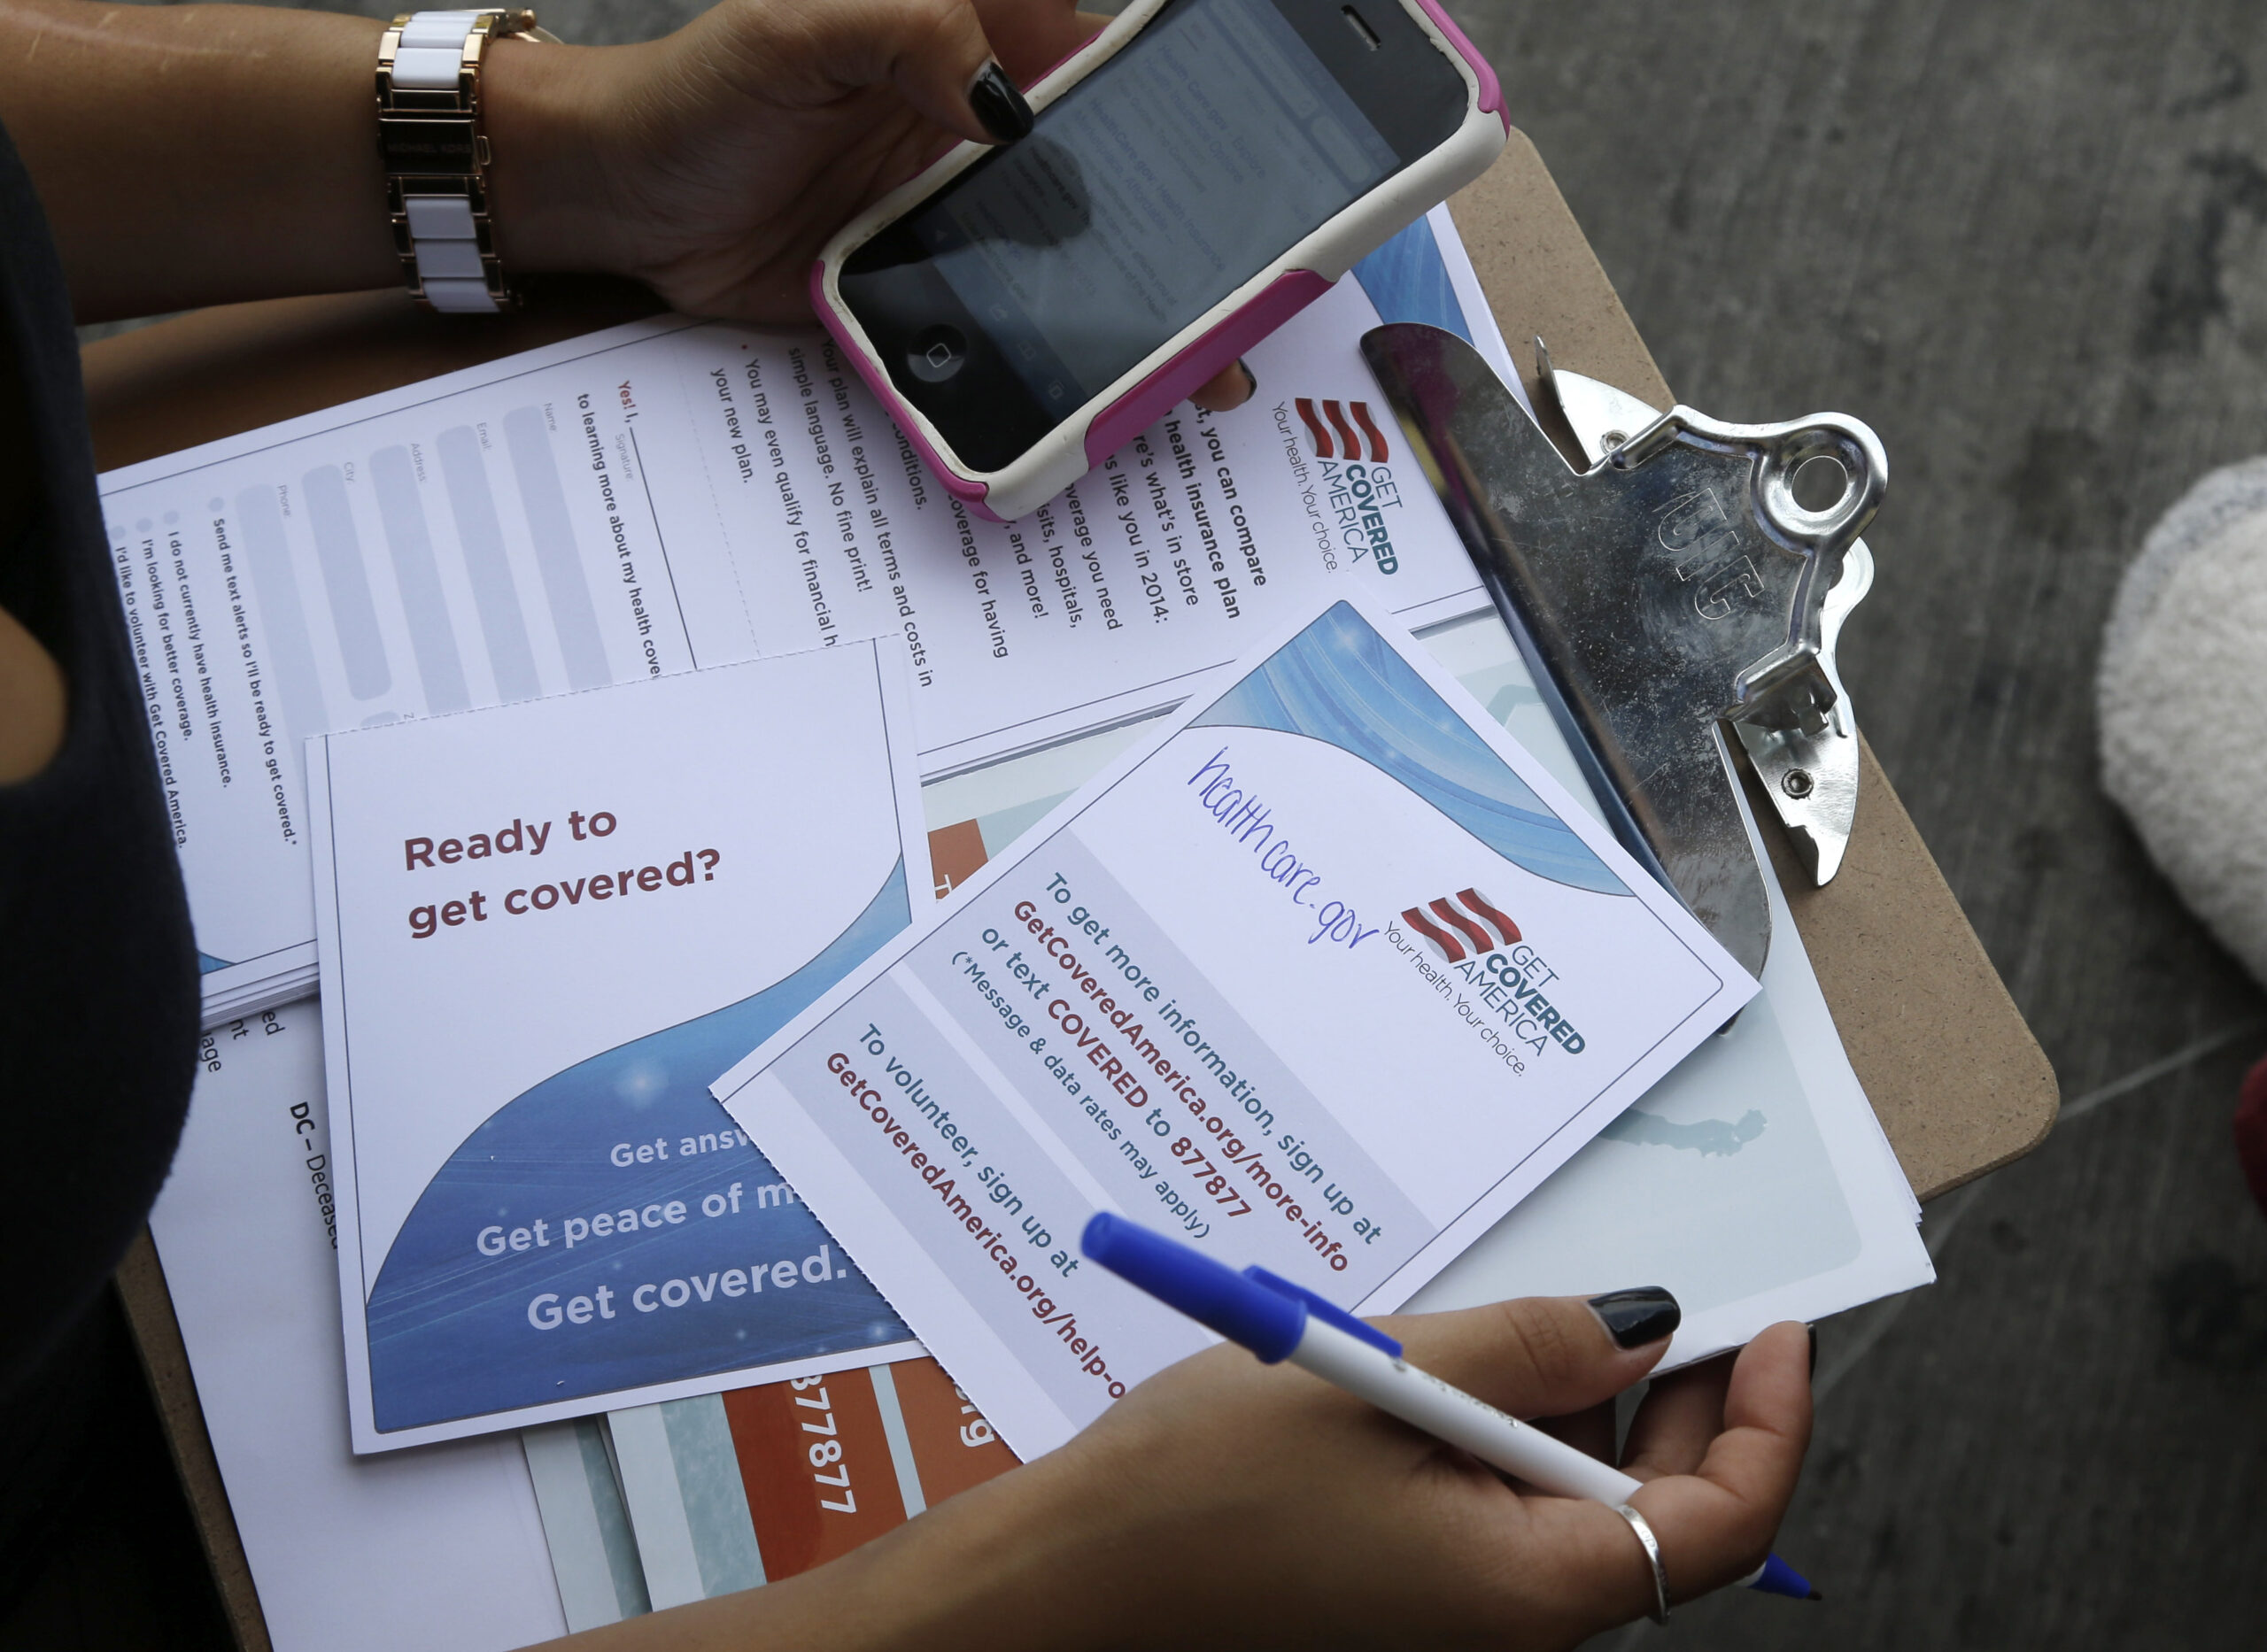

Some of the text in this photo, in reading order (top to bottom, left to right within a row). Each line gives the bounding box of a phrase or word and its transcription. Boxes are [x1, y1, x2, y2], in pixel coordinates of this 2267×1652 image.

[577, 393, 590, 410] to
[617, 380, 638, 423] Yes! I,
[709, 367, 754, 483] your new plan.
[582, 412, 607, 471] learning
[787, 346, 873, 592] simple language. No fine print!
[598, 474, 616, 512] more
[745, 351, 836, 631] You may even qualify for financial
[1145, 471, 1176, 532] what's
[1200, 427, 1266, 586] you can compare
[1272, 400, 1338, 574] Your health. Your choice.
[1317, 460, 1369, 564] AMERICA
[1371, 466, 1404, 508] GET
[170, 539, 182, 557] do
[213, 518, 231, 551] Send
[609, 515, 631, 559] about
[827, 376, 933, 688] plan will explain all terms and costs in
[1109, 473, 1170, 624] like you in 2014:
[1164, 420, 1241, 619] health insurance plan
[1165, 535, 1182, 554] in
[1345, 464, 1399, 575] COVERED
[174, 560, 189, 582] not
[221, 553, 233, 573] me
[226, 575, 242, 602] text
[621, 561, 637, 583] my
[1009, 533, 1049, 619] and more!
[1048, 544, 1084, 629] hospitals,
[1081, 551, 1124, 630] you need
[1173, 559, 1199, 606] store
[142, 538, 192, 741] I'm looking for better coverage.
[180, 584, 201, 640] currently
[232, 605, 249, 641] alerts
[628, 587, 653, 636] health
[192, 643, 207, 675] have
[241, 643, 252, 659] so
[245, 660, 259, 678] I'll
[115, 546, 187, 849] I'd like to volunteer with Get Covered America.
[199, 676, 220, 719] health
[249, 679, 261, 698] be
[254, 700, 272, 737] ready
[209, 720, 232, 788] insurance.
[263, 740, 275, 755] to
[265, 758, 282, 782] get
[404, 810, 617, 871] Ready to
[408, 848, 721, 939] get covered?
[1512, 945, 1559, 987] GET
[1383, 920, 1525, 1077] Your health. Your choice.
[1453, 960, 1548, 1057] AMERICA
[1486, 953, 1586, 1055] COVERED
[981, 928, 1252, 1217] or text COVERED to 877877
[1014, 900, 1348, 1271] GetCoveredAmerica.org/more-info
[1046, 871, 1381, 1245] To get more information, sign up at
[290, 1101, 316, 1135] DC
[1029, 1037, 1047, 1055] &
[1043, 1054, 1081, 1096] data
[1079, 1095, 1122, 1141] rates
[1118, 1140, 1158, 1179] may
[1155, 1180, 1210, 1239] apply)
[610, 1138, 669, 1168] Get
[859, 1023, 1079, 1278] To volunteer, sign up at
[476, 1182, 743, 1256] Get peace of
[527, 1245, 847, 1331] Get covered.
